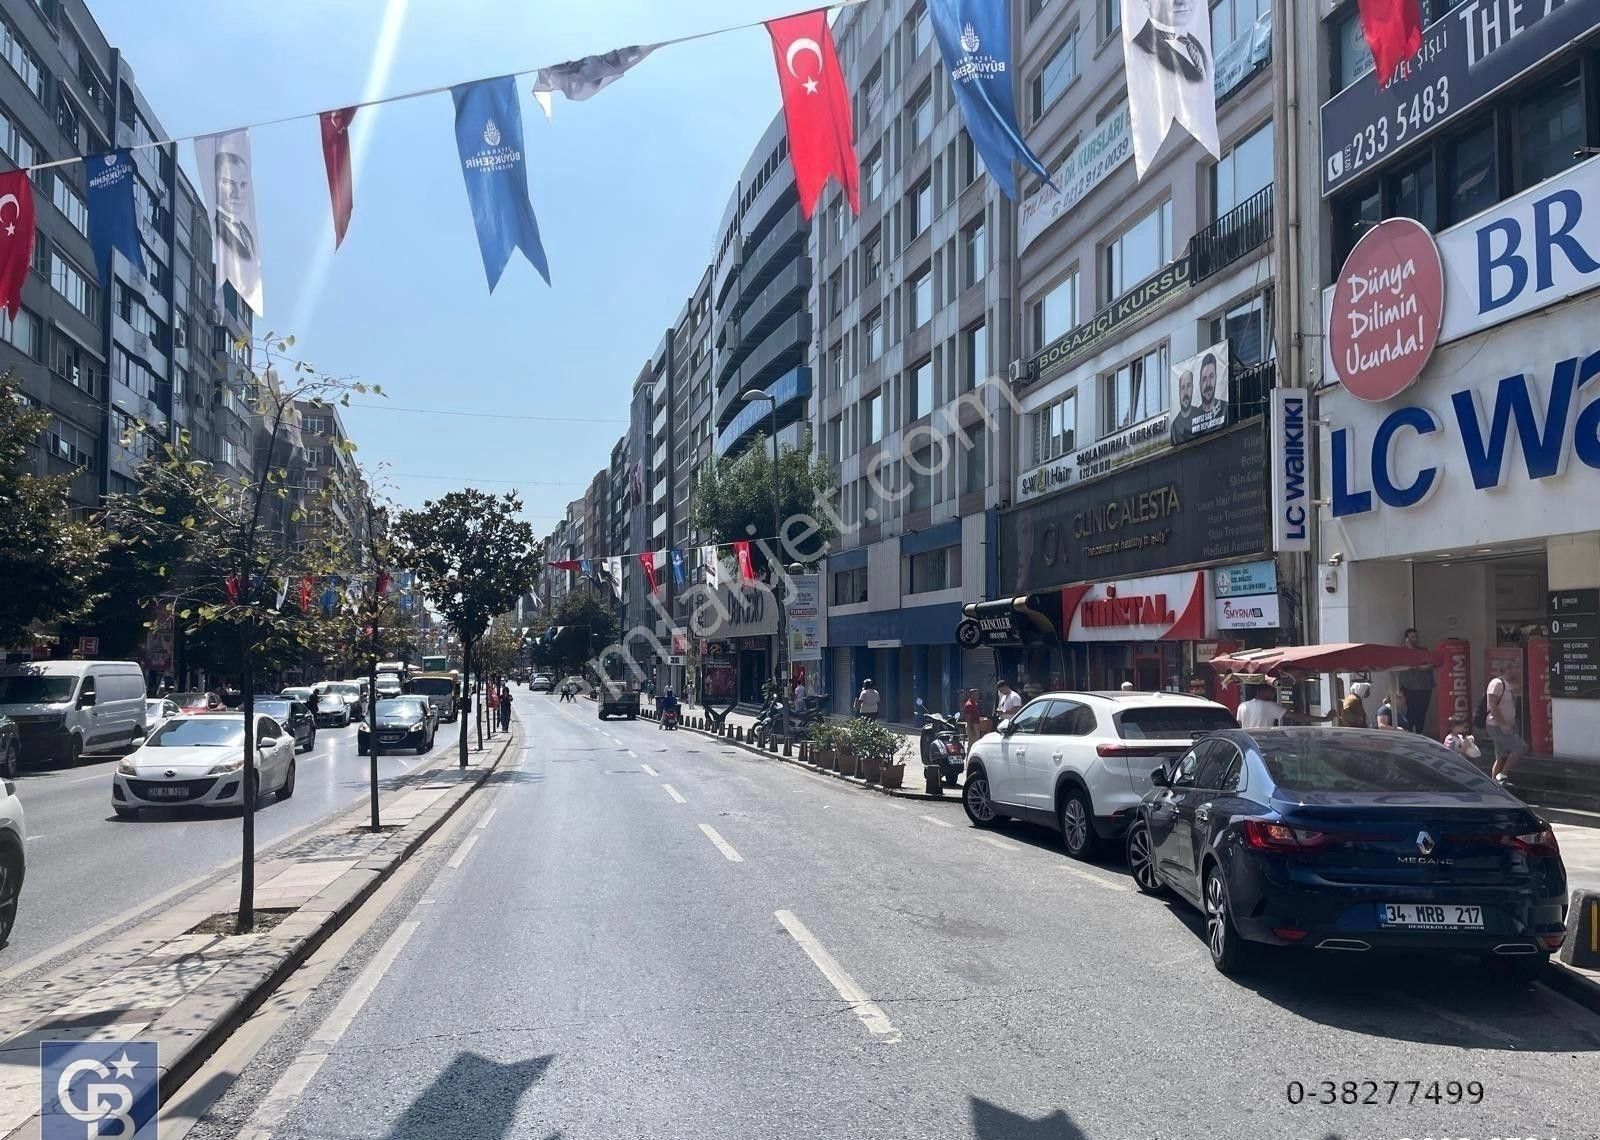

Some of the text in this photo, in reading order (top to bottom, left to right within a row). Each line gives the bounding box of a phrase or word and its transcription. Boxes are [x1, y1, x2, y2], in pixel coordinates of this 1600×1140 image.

[1417, 24, 1448, 72] ŞİŞLİ
[1460, 0, 1525, 67] THE
[1353, 115, 1389, 169] 233
[1396, 75, 1450, 141] 5483
[1476, 189, 1600, 315] BR
[1348, 258, 1416, 304] Dünya
[1039, 315, 1113, 369] BOĞAZİÇİ
[1118, 261, 1190, 320] KURSU
[1347, 294, 1418, 339] Dilimin
[1345, 315, 1425, 375] Ucunda!
[1331, 406, 1438, 518] LC
[1120, 484, 1180, 527] ALESTA
[1285, 505, 1305, 540] LC
[1552, 596, 1558, 610] 1
[1552, 620, 1559, 633] 0
[1552, 662, 1560, 675] -1
[1397, 857, 1455, 865] MEGANE
[1387, 906, 1406, 922] 34
[1455, 907, 1480, 923] 217
